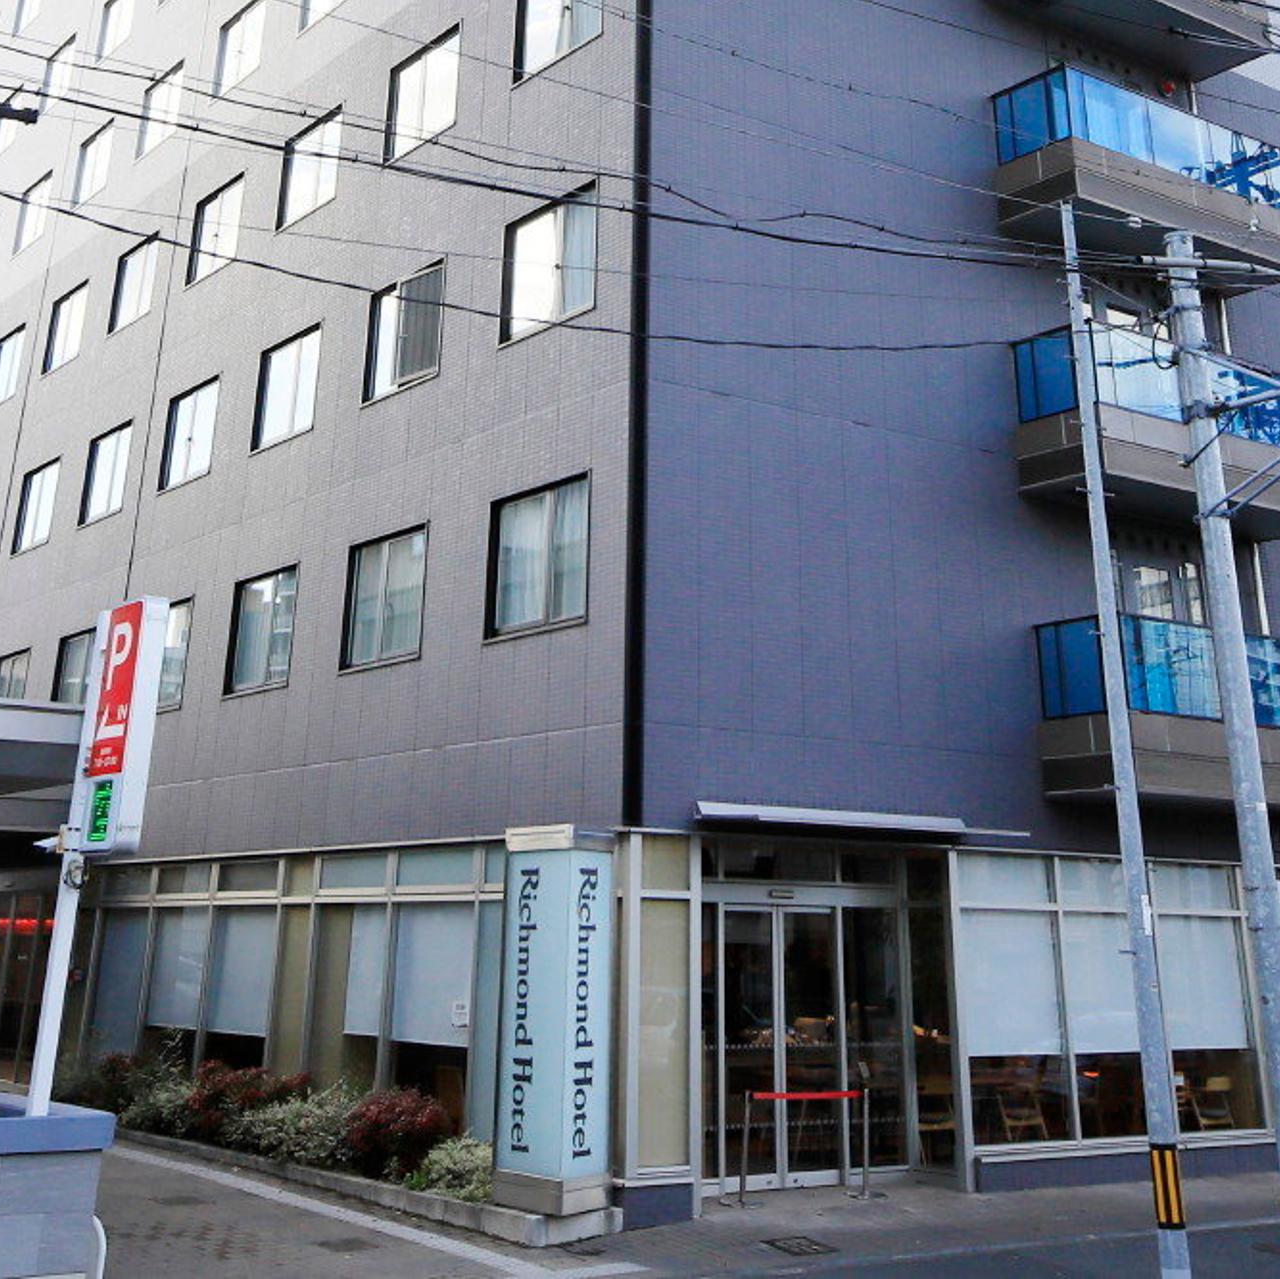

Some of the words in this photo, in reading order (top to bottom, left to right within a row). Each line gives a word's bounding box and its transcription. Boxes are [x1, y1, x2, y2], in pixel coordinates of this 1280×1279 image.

[106, 622, 133, 691] P
[513, 867, 540, 1047] Richmond
[575, 867, 598, 1050] Richmond
[511, 1056, 533, 1153] Hotel
[572, 1057, 593, 1159] Hotel
